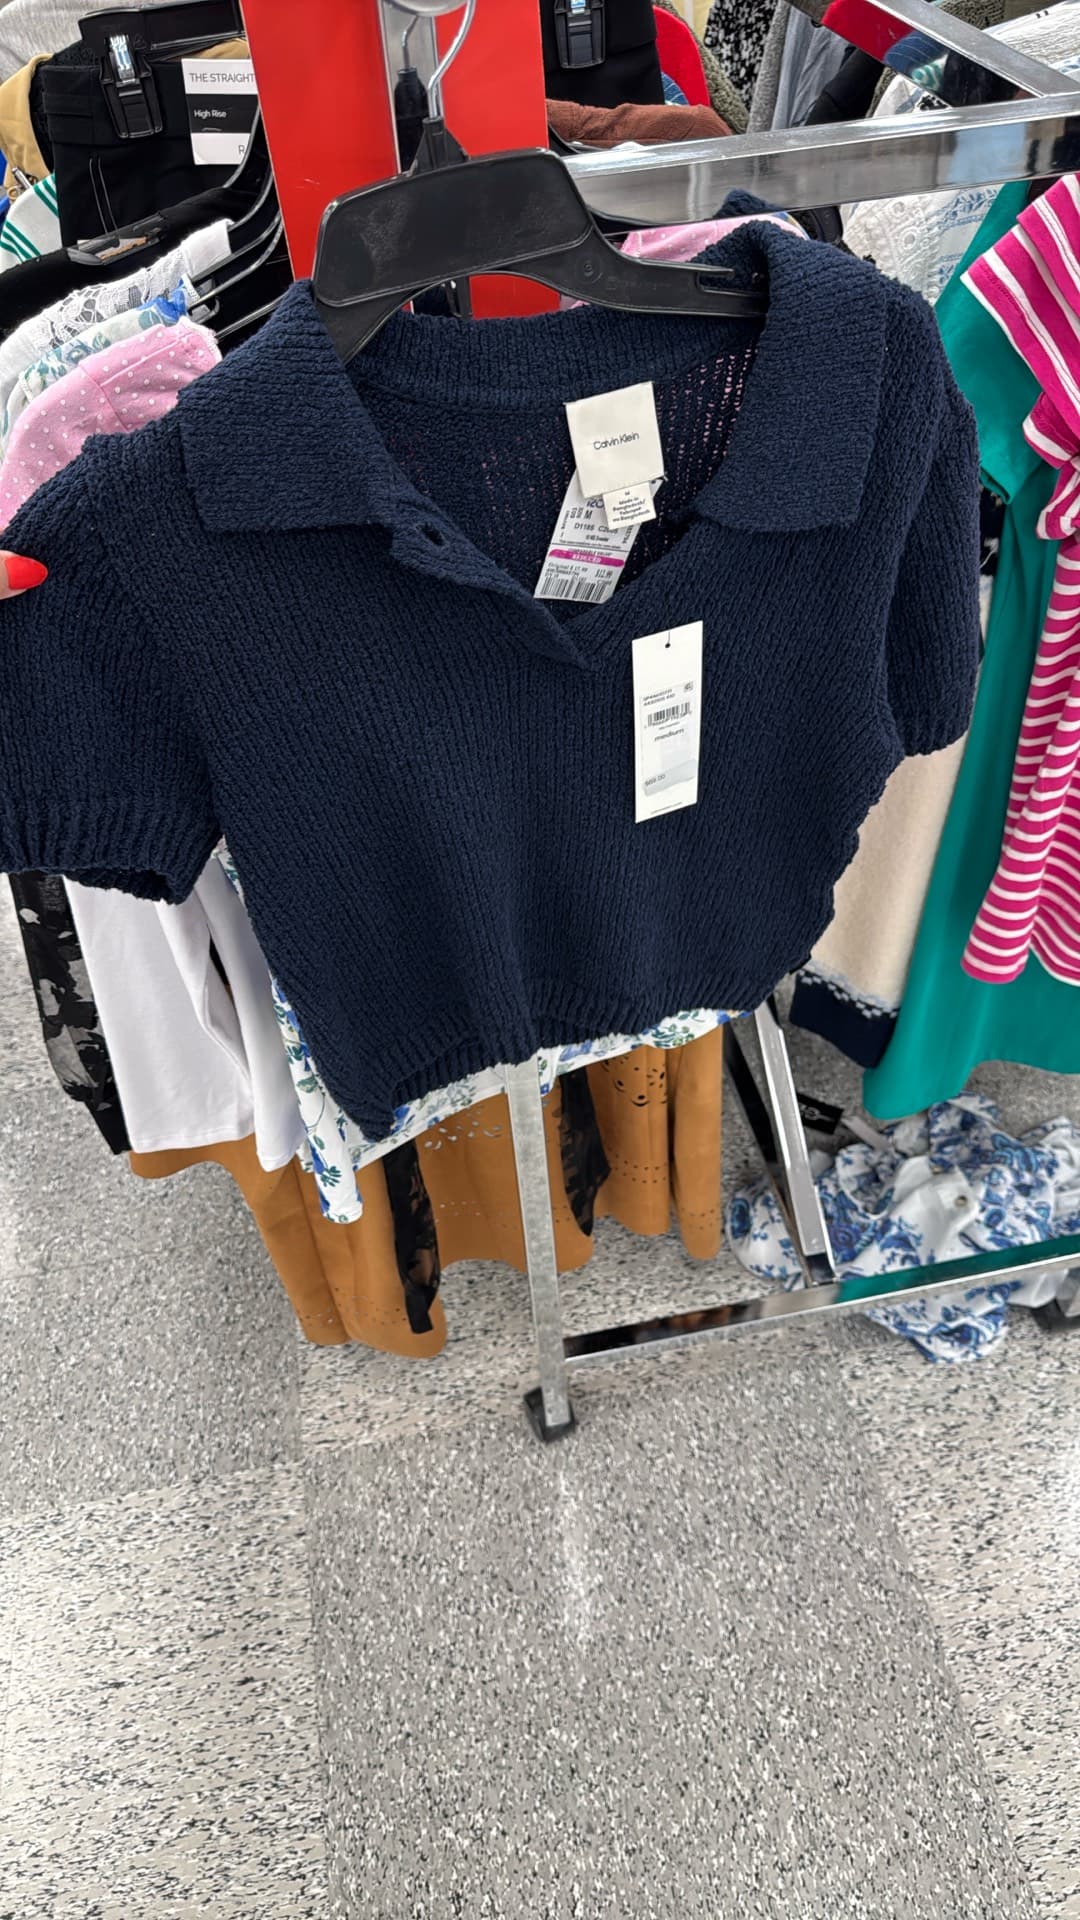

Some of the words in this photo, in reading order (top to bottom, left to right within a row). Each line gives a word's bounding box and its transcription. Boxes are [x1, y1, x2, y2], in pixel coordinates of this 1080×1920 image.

[189, 73, 208, 83] THE
[210, 73, 254, 83] STRAIGHT
[193, 109, 210, 120] High
[211, 109, 227, 118] Rise
[238, 145, 245, 155] R
[593, 437, 620, 450] Calvin
[619, 431, 640, 443] Klein
[583, 509, 594, 521] M
[654, 728, 685, 742] medium
